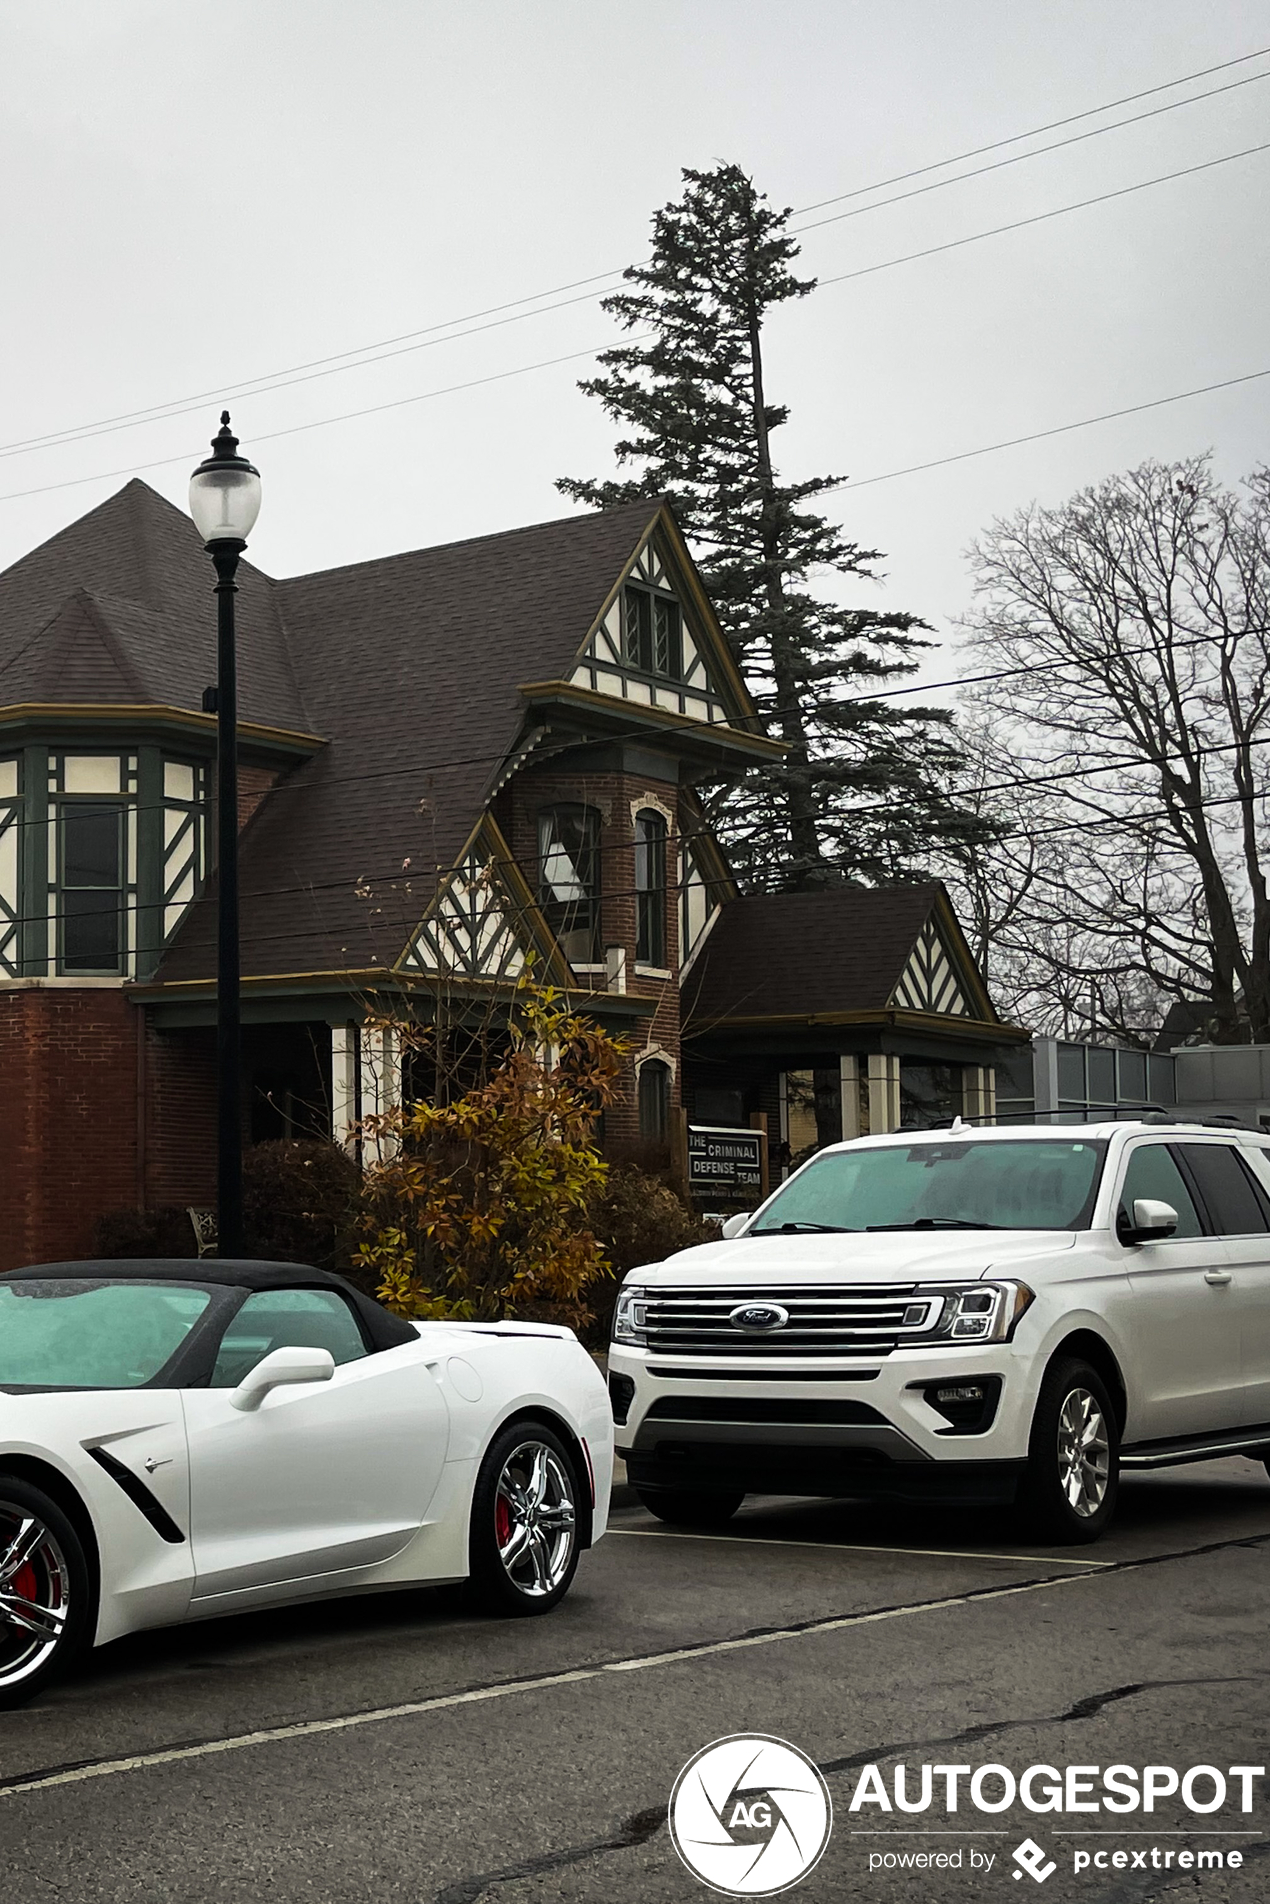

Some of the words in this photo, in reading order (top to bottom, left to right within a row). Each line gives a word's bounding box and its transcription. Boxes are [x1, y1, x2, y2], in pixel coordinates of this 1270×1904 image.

[689, 1134, 706, 1148] THE
[708, 1144, 755, 1159] CRIMINAL
[694, 1160, 735, 1175] DEFENSE
[737, 1172, 760, 1185] TEAM
[743, 1310, 771, 1322] Ford
